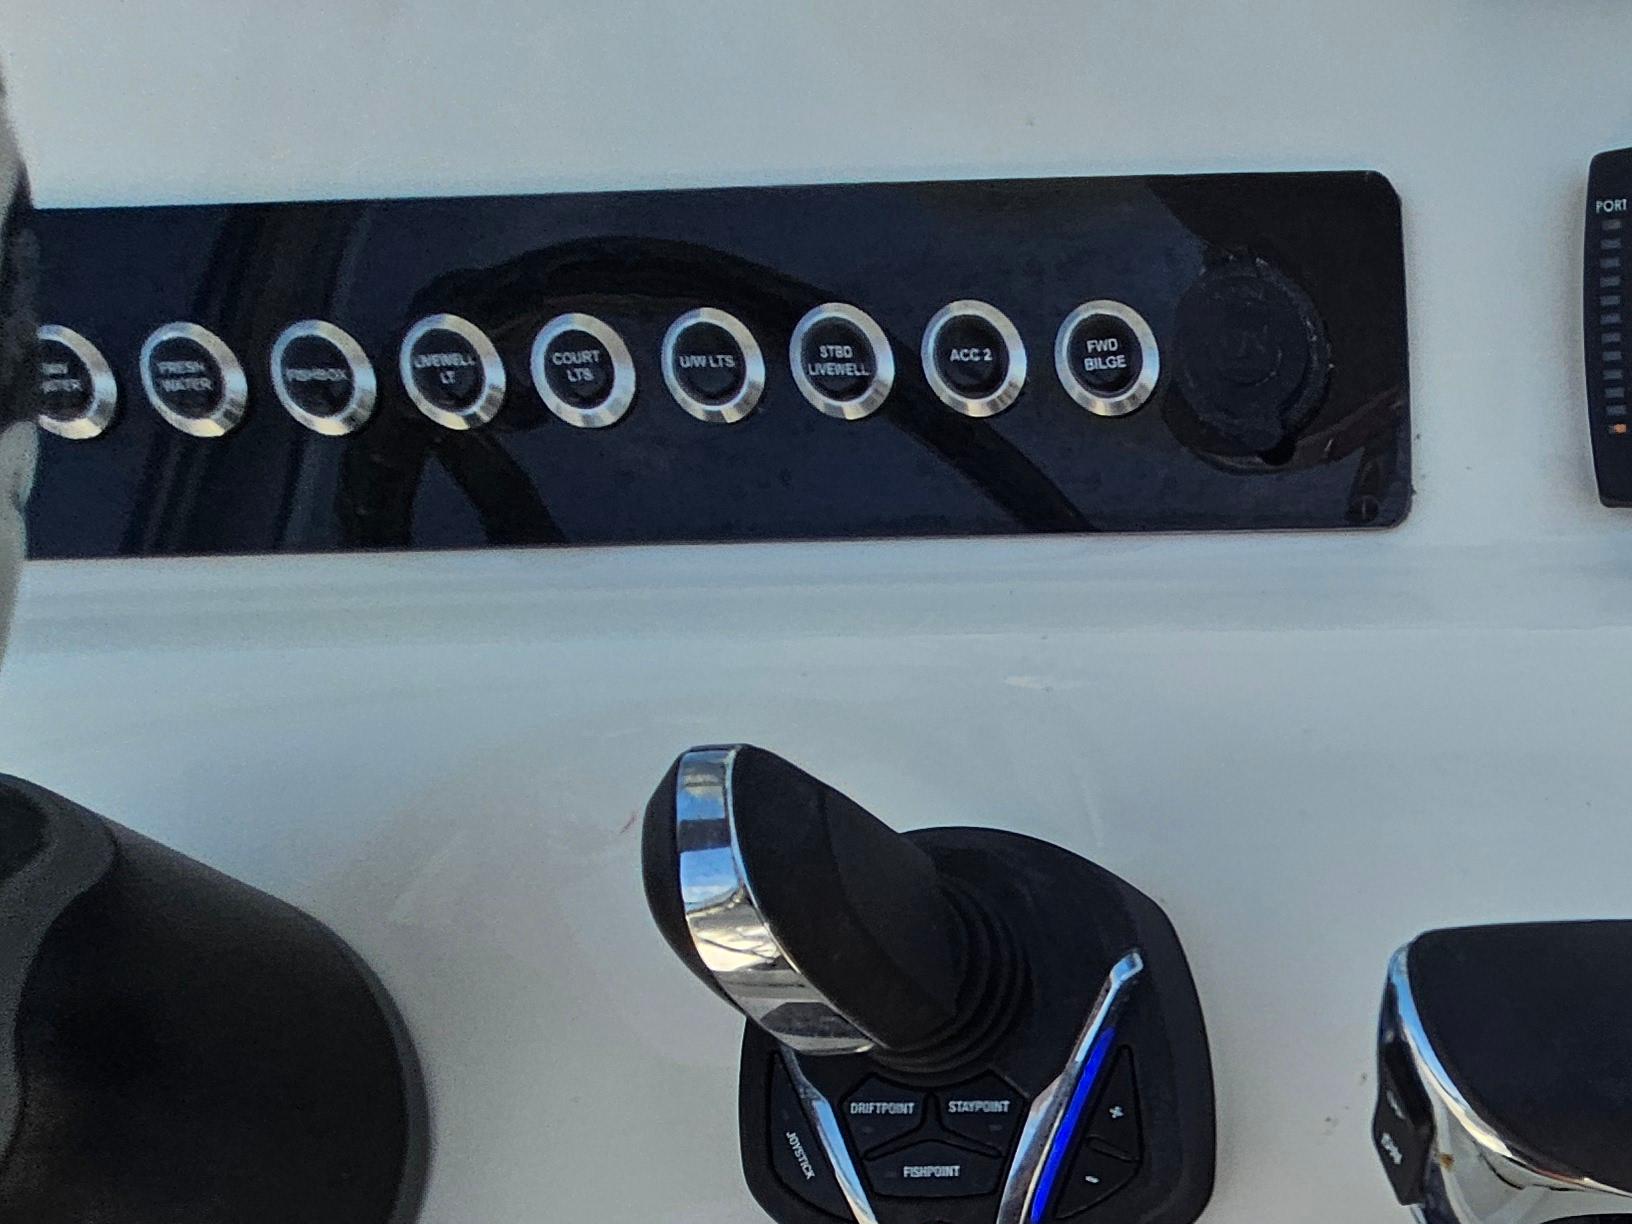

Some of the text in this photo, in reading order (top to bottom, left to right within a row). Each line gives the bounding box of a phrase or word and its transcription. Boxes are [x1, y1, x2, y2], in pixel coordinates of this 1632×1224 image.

[1596, 199, 1627, 213] PORT
[819, 344, 853, 359] STBD
[1086, 338, 1118, 353] FWD
[552, 350, 600, 366] COURT
[708, 354, 735, 368] LTS
[950, 348, 993, 362] ACC 2
[1084, 354, 1127, 371] BILGE
[567, 368, 594, 383] LTS
[808, 361, 870, 377] LIVEWELL
[161, 377, 213, 392] WATER
[440, 370, 456, 385] LT
[850, 1101, 914, 1115] DRIFTPOINT
[948, 1100, 1010, 1113] STAYPOINT
[786, 1131, 816, 1180] JOYSTICK
[903, 1165, 960, 1178] FISHPOINT
